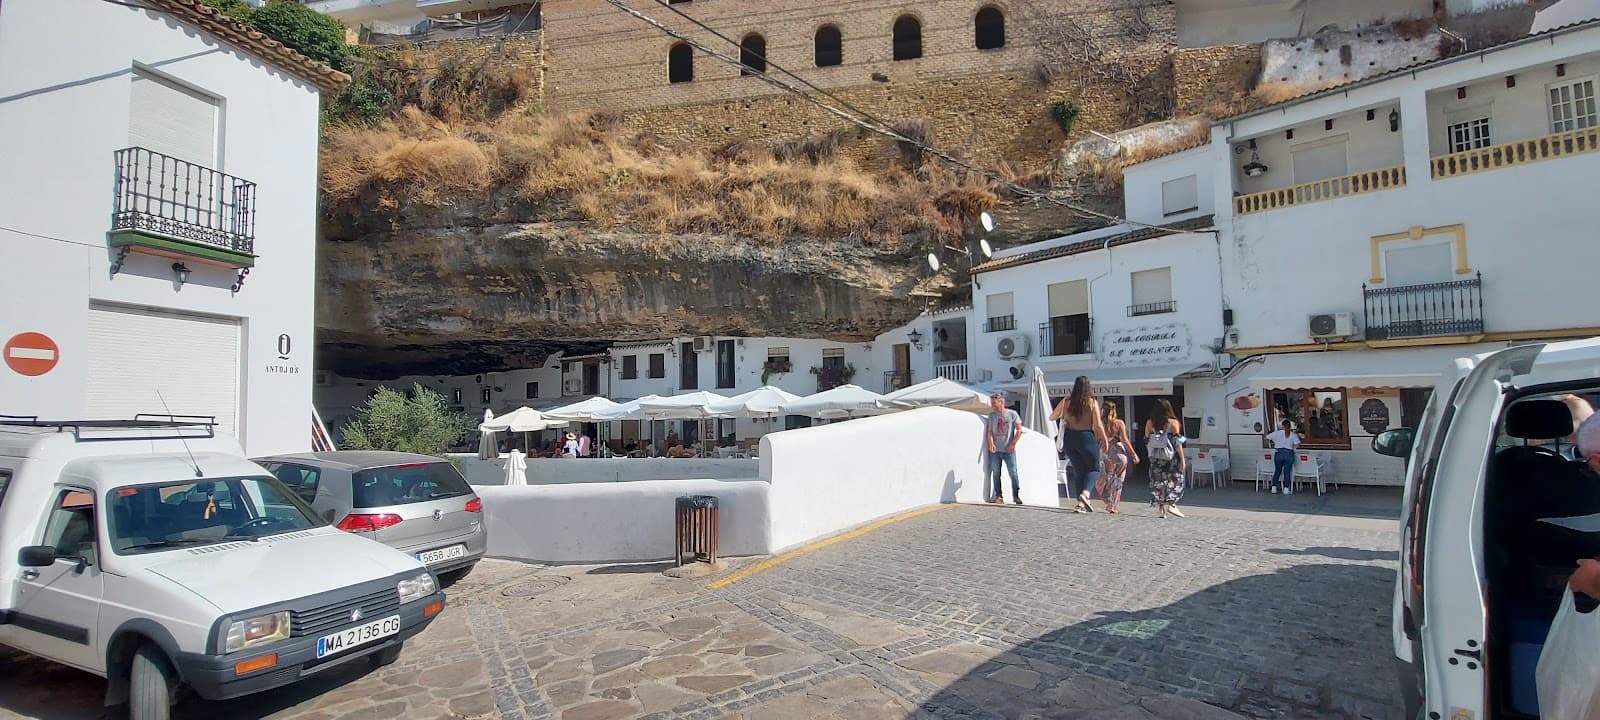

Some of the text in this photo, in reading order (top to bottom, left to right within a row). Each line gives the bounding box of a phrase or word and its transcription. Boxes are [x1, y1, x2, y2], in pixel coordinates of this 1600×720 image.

[1093, 386, 1121, 394] UENTE
[422, 547, 460, 563] 5658 JGR
[325, 618, 400, 653] MA 2136 CG
